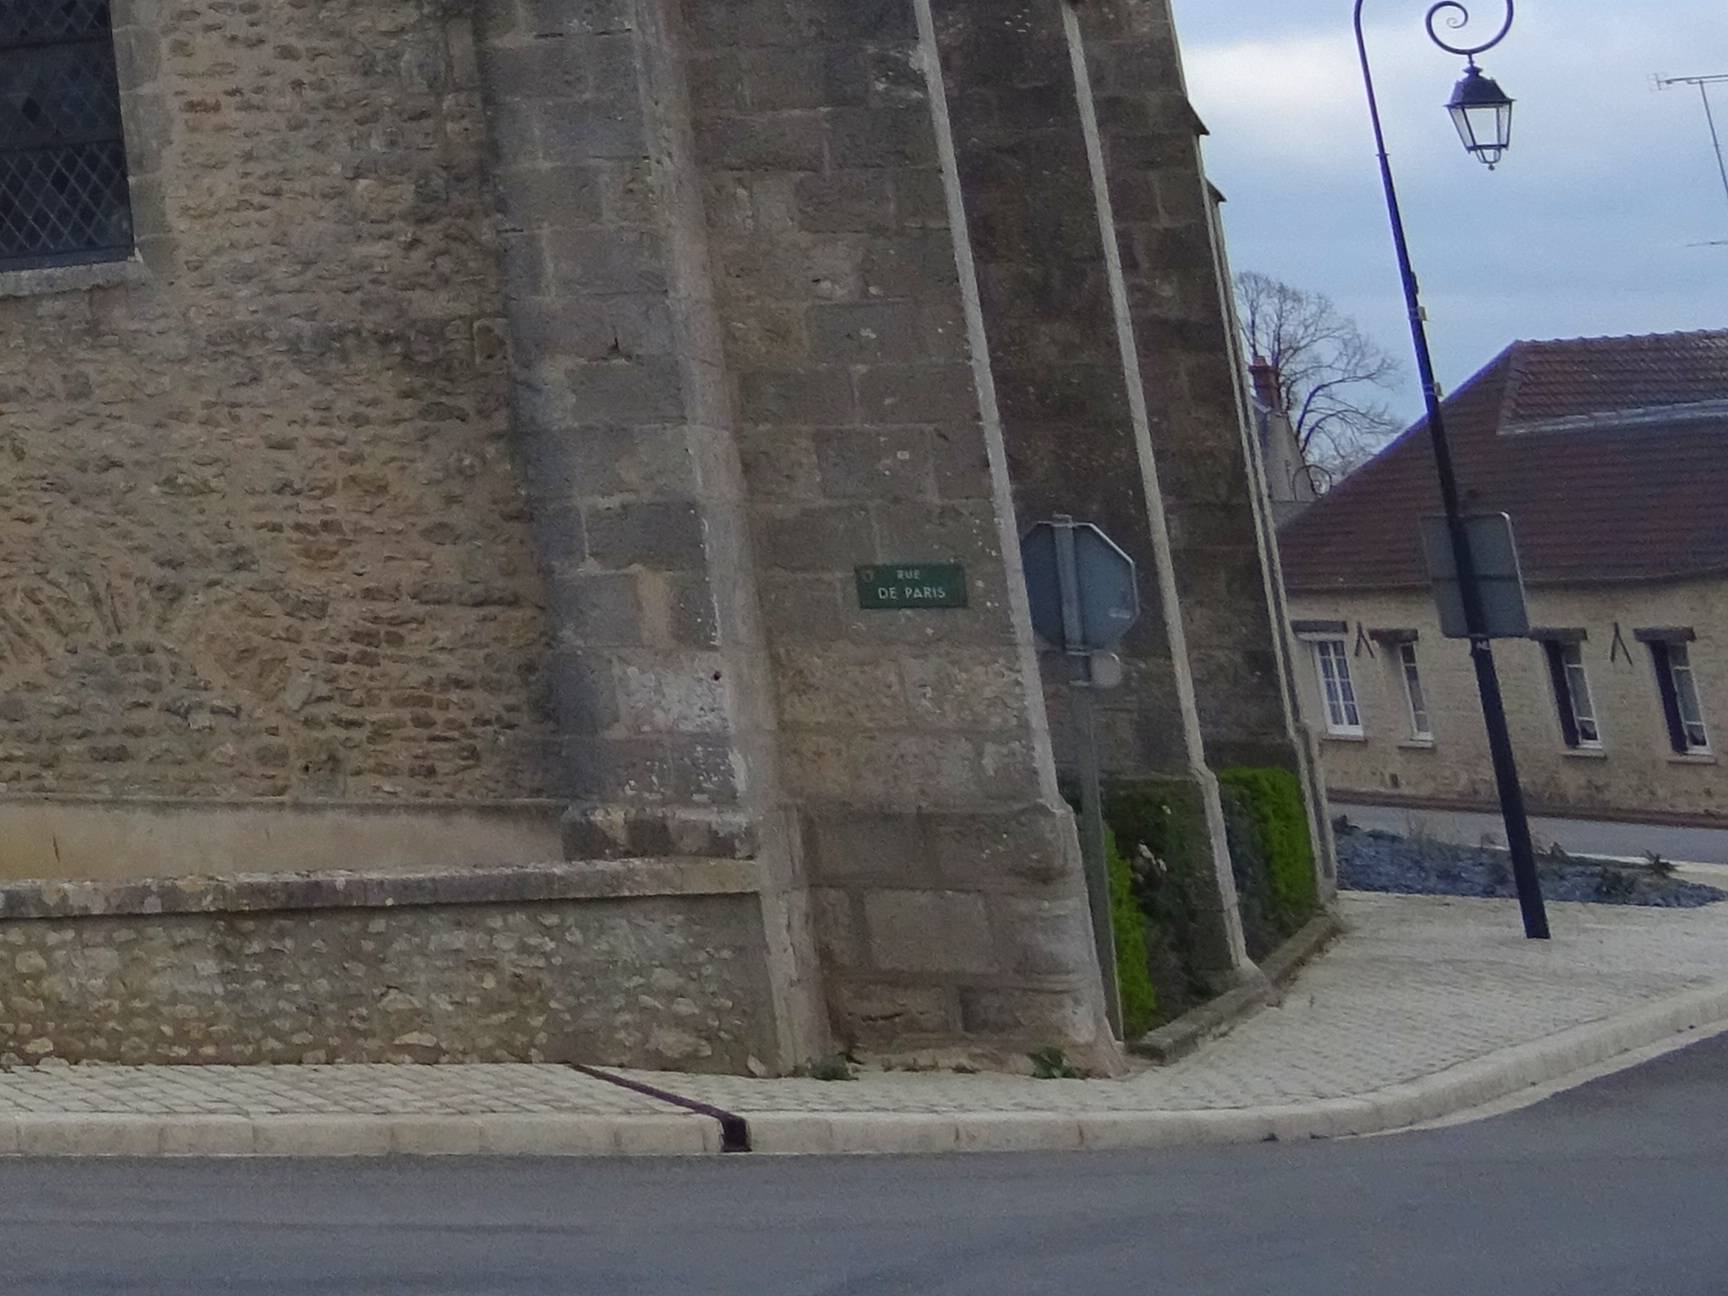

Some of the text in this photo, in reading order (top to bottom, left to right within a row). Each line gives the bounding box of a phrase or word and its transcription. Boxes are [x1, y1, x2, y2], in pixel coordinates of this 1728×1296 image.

[896, 569, 921, 580] RUE
[877, 586, 946, 600] DE PARIS
